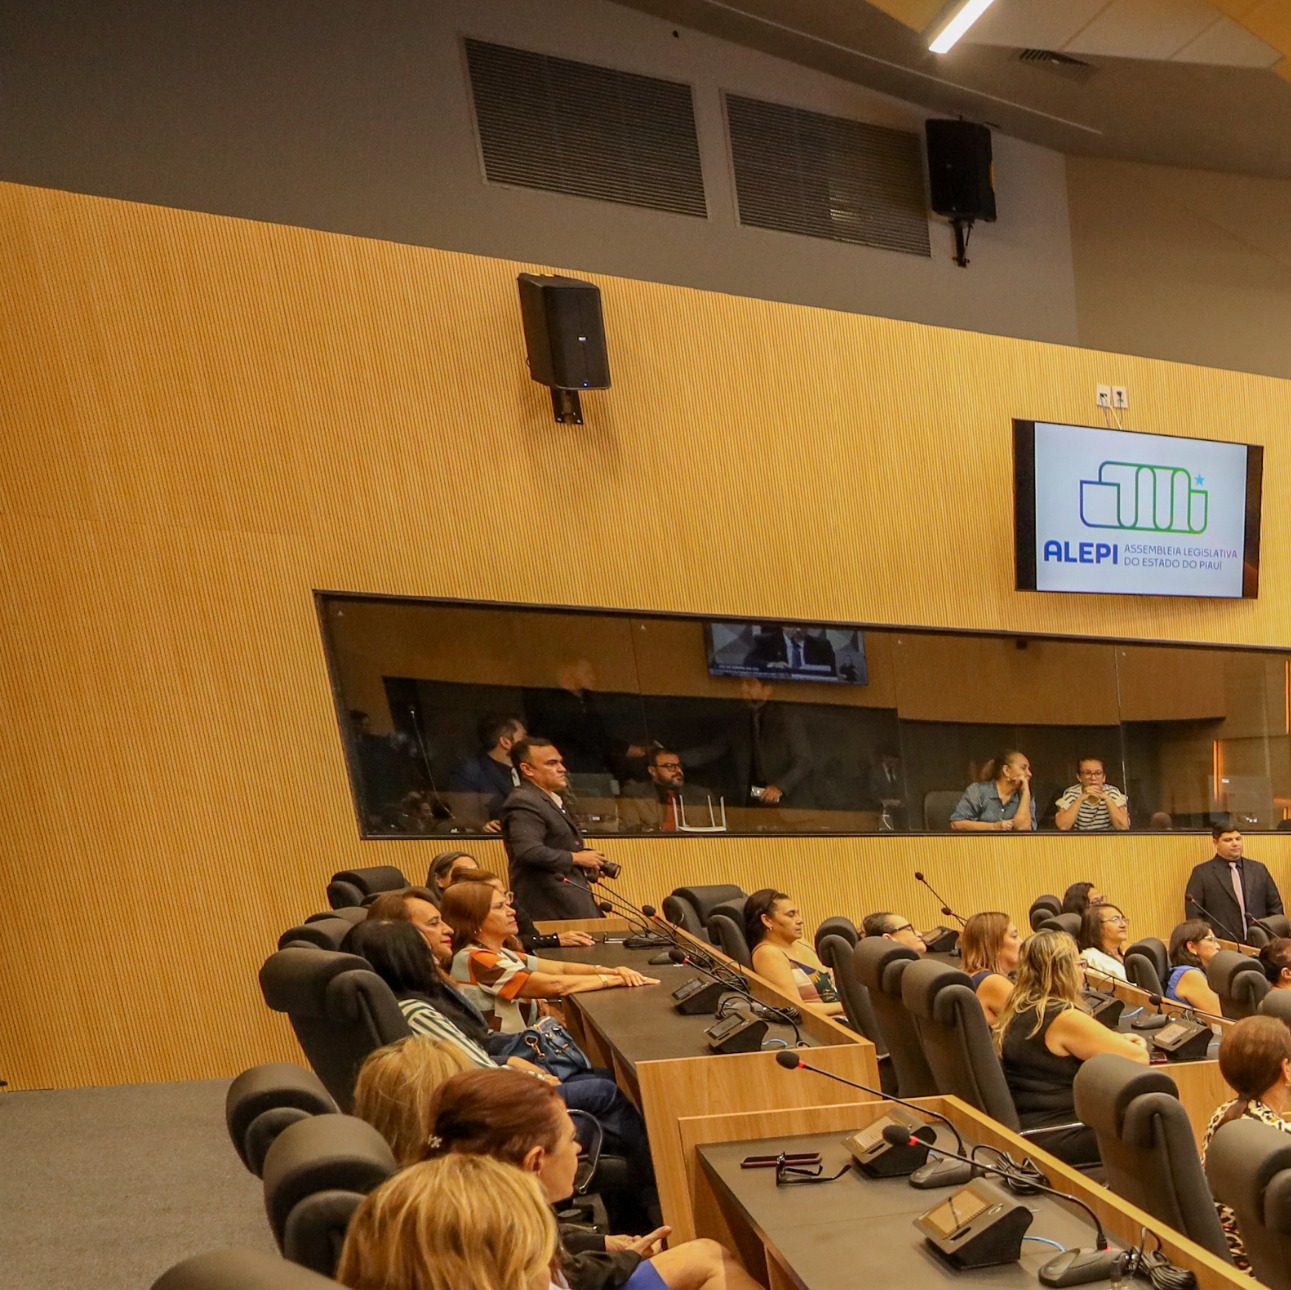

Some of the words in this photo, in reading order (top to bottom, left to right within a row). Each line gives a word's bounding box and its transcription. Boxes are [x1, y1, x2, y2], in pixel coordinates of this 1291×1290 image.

[1043, 539, 1118, 566] ALEPI
[1123, 543, 1182, 557] ASSEMBLEIA
[1183, 546, 1238, 559] LEGISLATIVA
[1123, 556, 1140, 567] DO
[1141, 557, 1180, 568] ESTADO
[1181, 559, 1198, 569] DO
